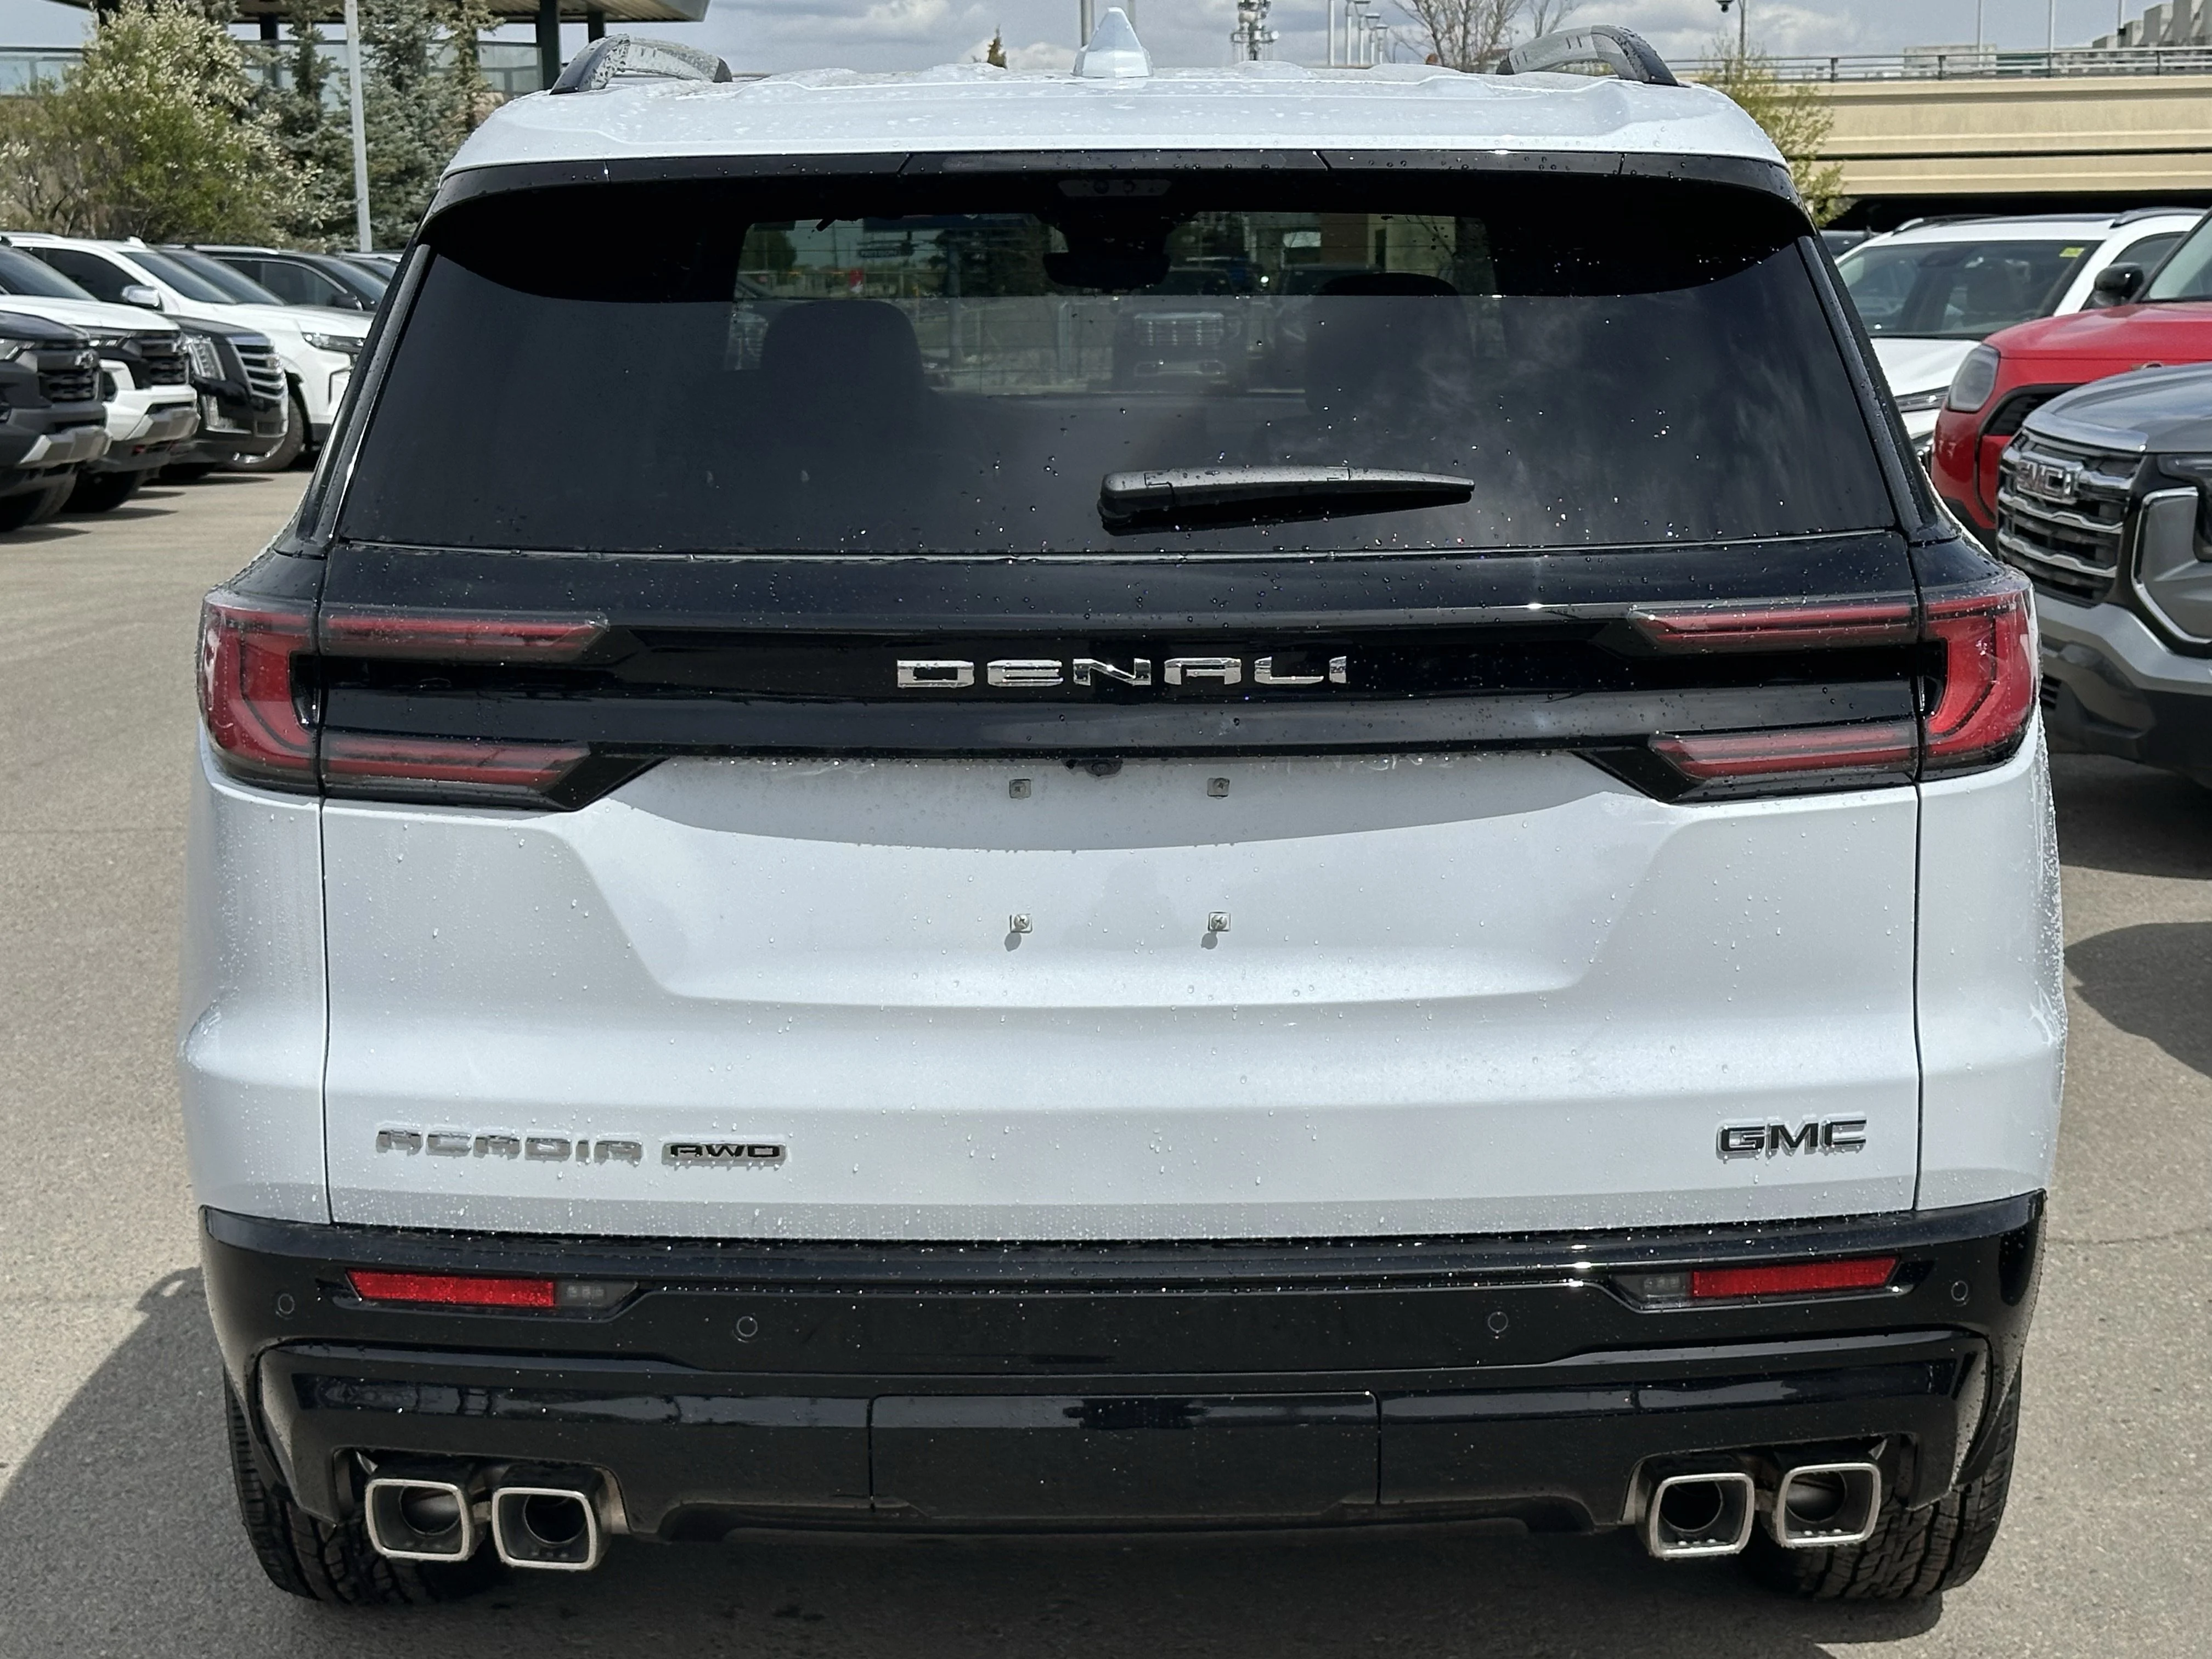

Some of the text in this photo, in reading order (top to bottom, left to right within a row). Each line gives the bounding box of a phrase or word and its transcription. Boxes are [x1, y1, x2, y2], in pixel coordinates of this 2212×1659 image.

[896, 656, 1347, 688] DENALI
[376, 1128, 783, 1164] ACADIA AWD
[1717, 1118, 1867, 1158] GMC
